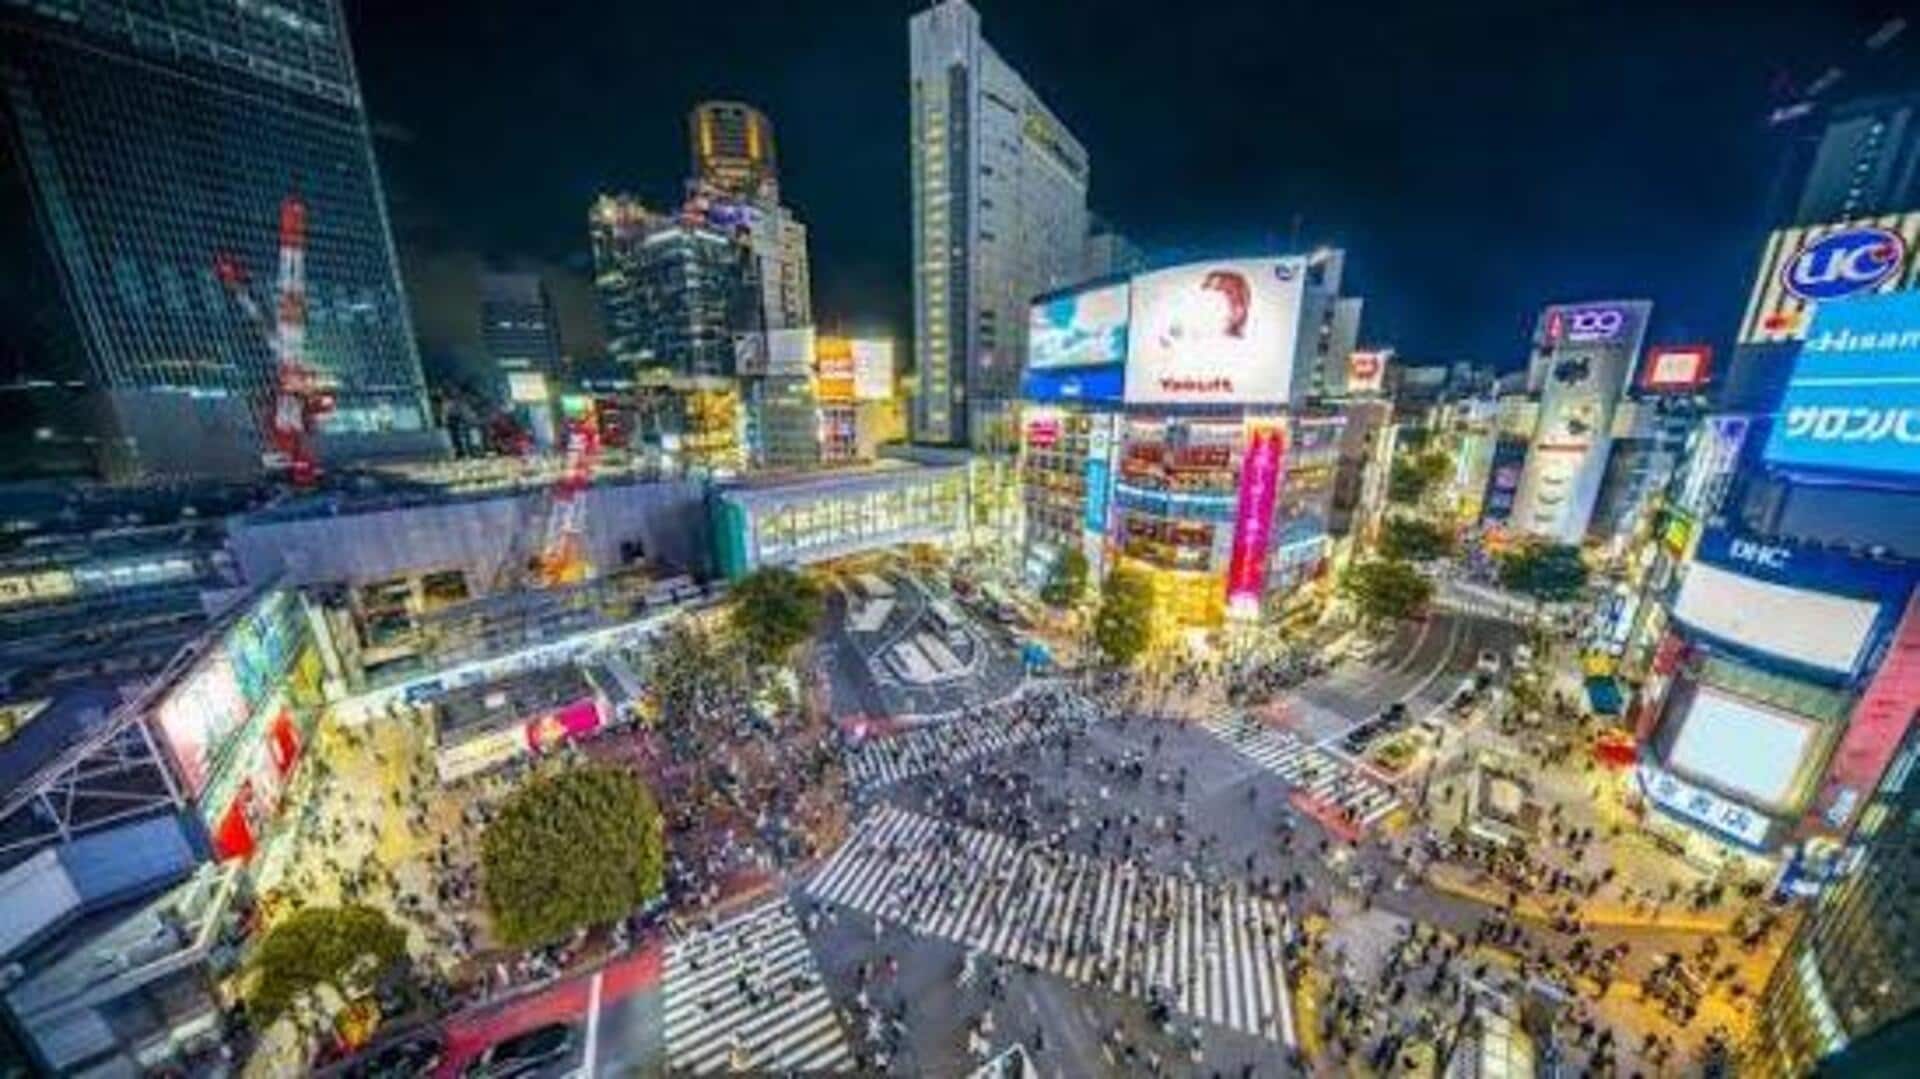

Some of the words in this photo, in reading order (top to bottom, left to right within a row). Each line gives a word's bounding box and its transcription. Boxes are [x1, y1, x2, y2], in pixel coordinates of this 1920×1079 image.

[1793, 243, 1889, 284] UC
[1571, 310, 1623, 338] 109
[1729, 538, 1791, 569] DHC
